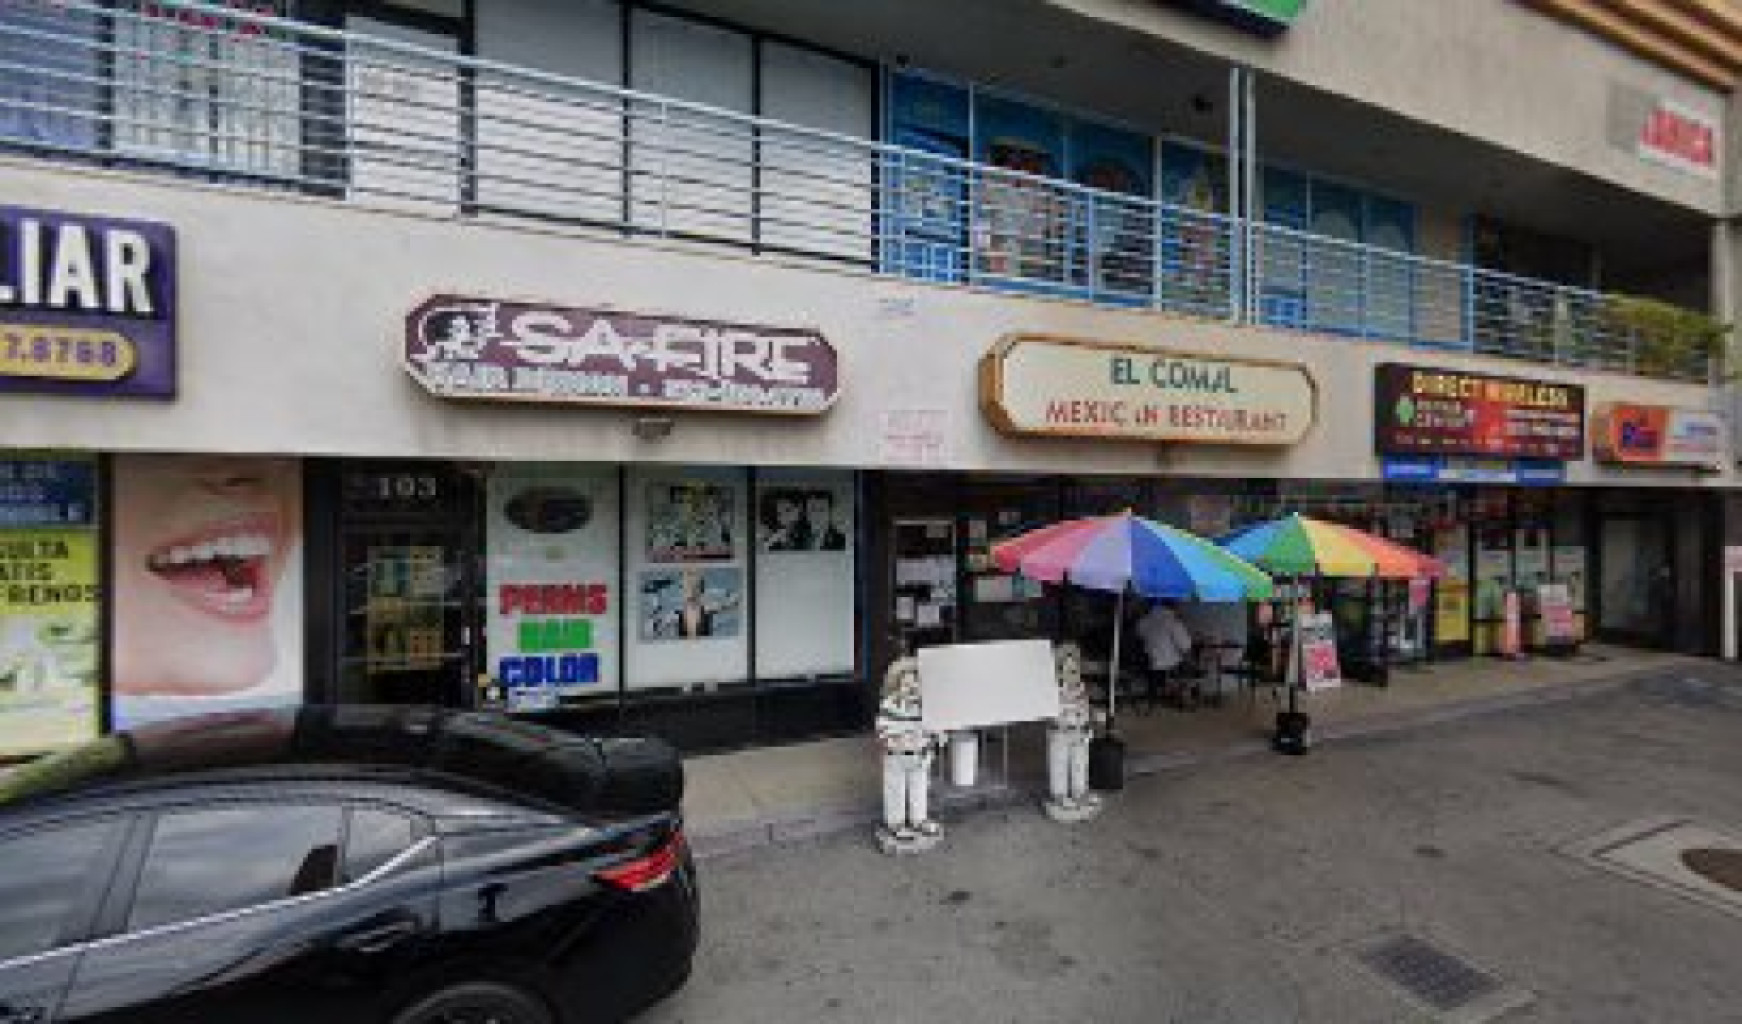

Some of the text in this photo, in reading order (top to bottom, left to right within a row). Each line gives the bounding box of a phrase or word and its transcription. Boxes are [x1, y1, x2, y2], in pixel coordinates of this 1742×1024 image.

[1109, 358, 1140, 385] EL
[379, 477, 436, 497] 103
[0, 584, 100, 605] RENOS
[499, 584, 607, 616] PERMS
[499, 652, 600, 687] COLOR
